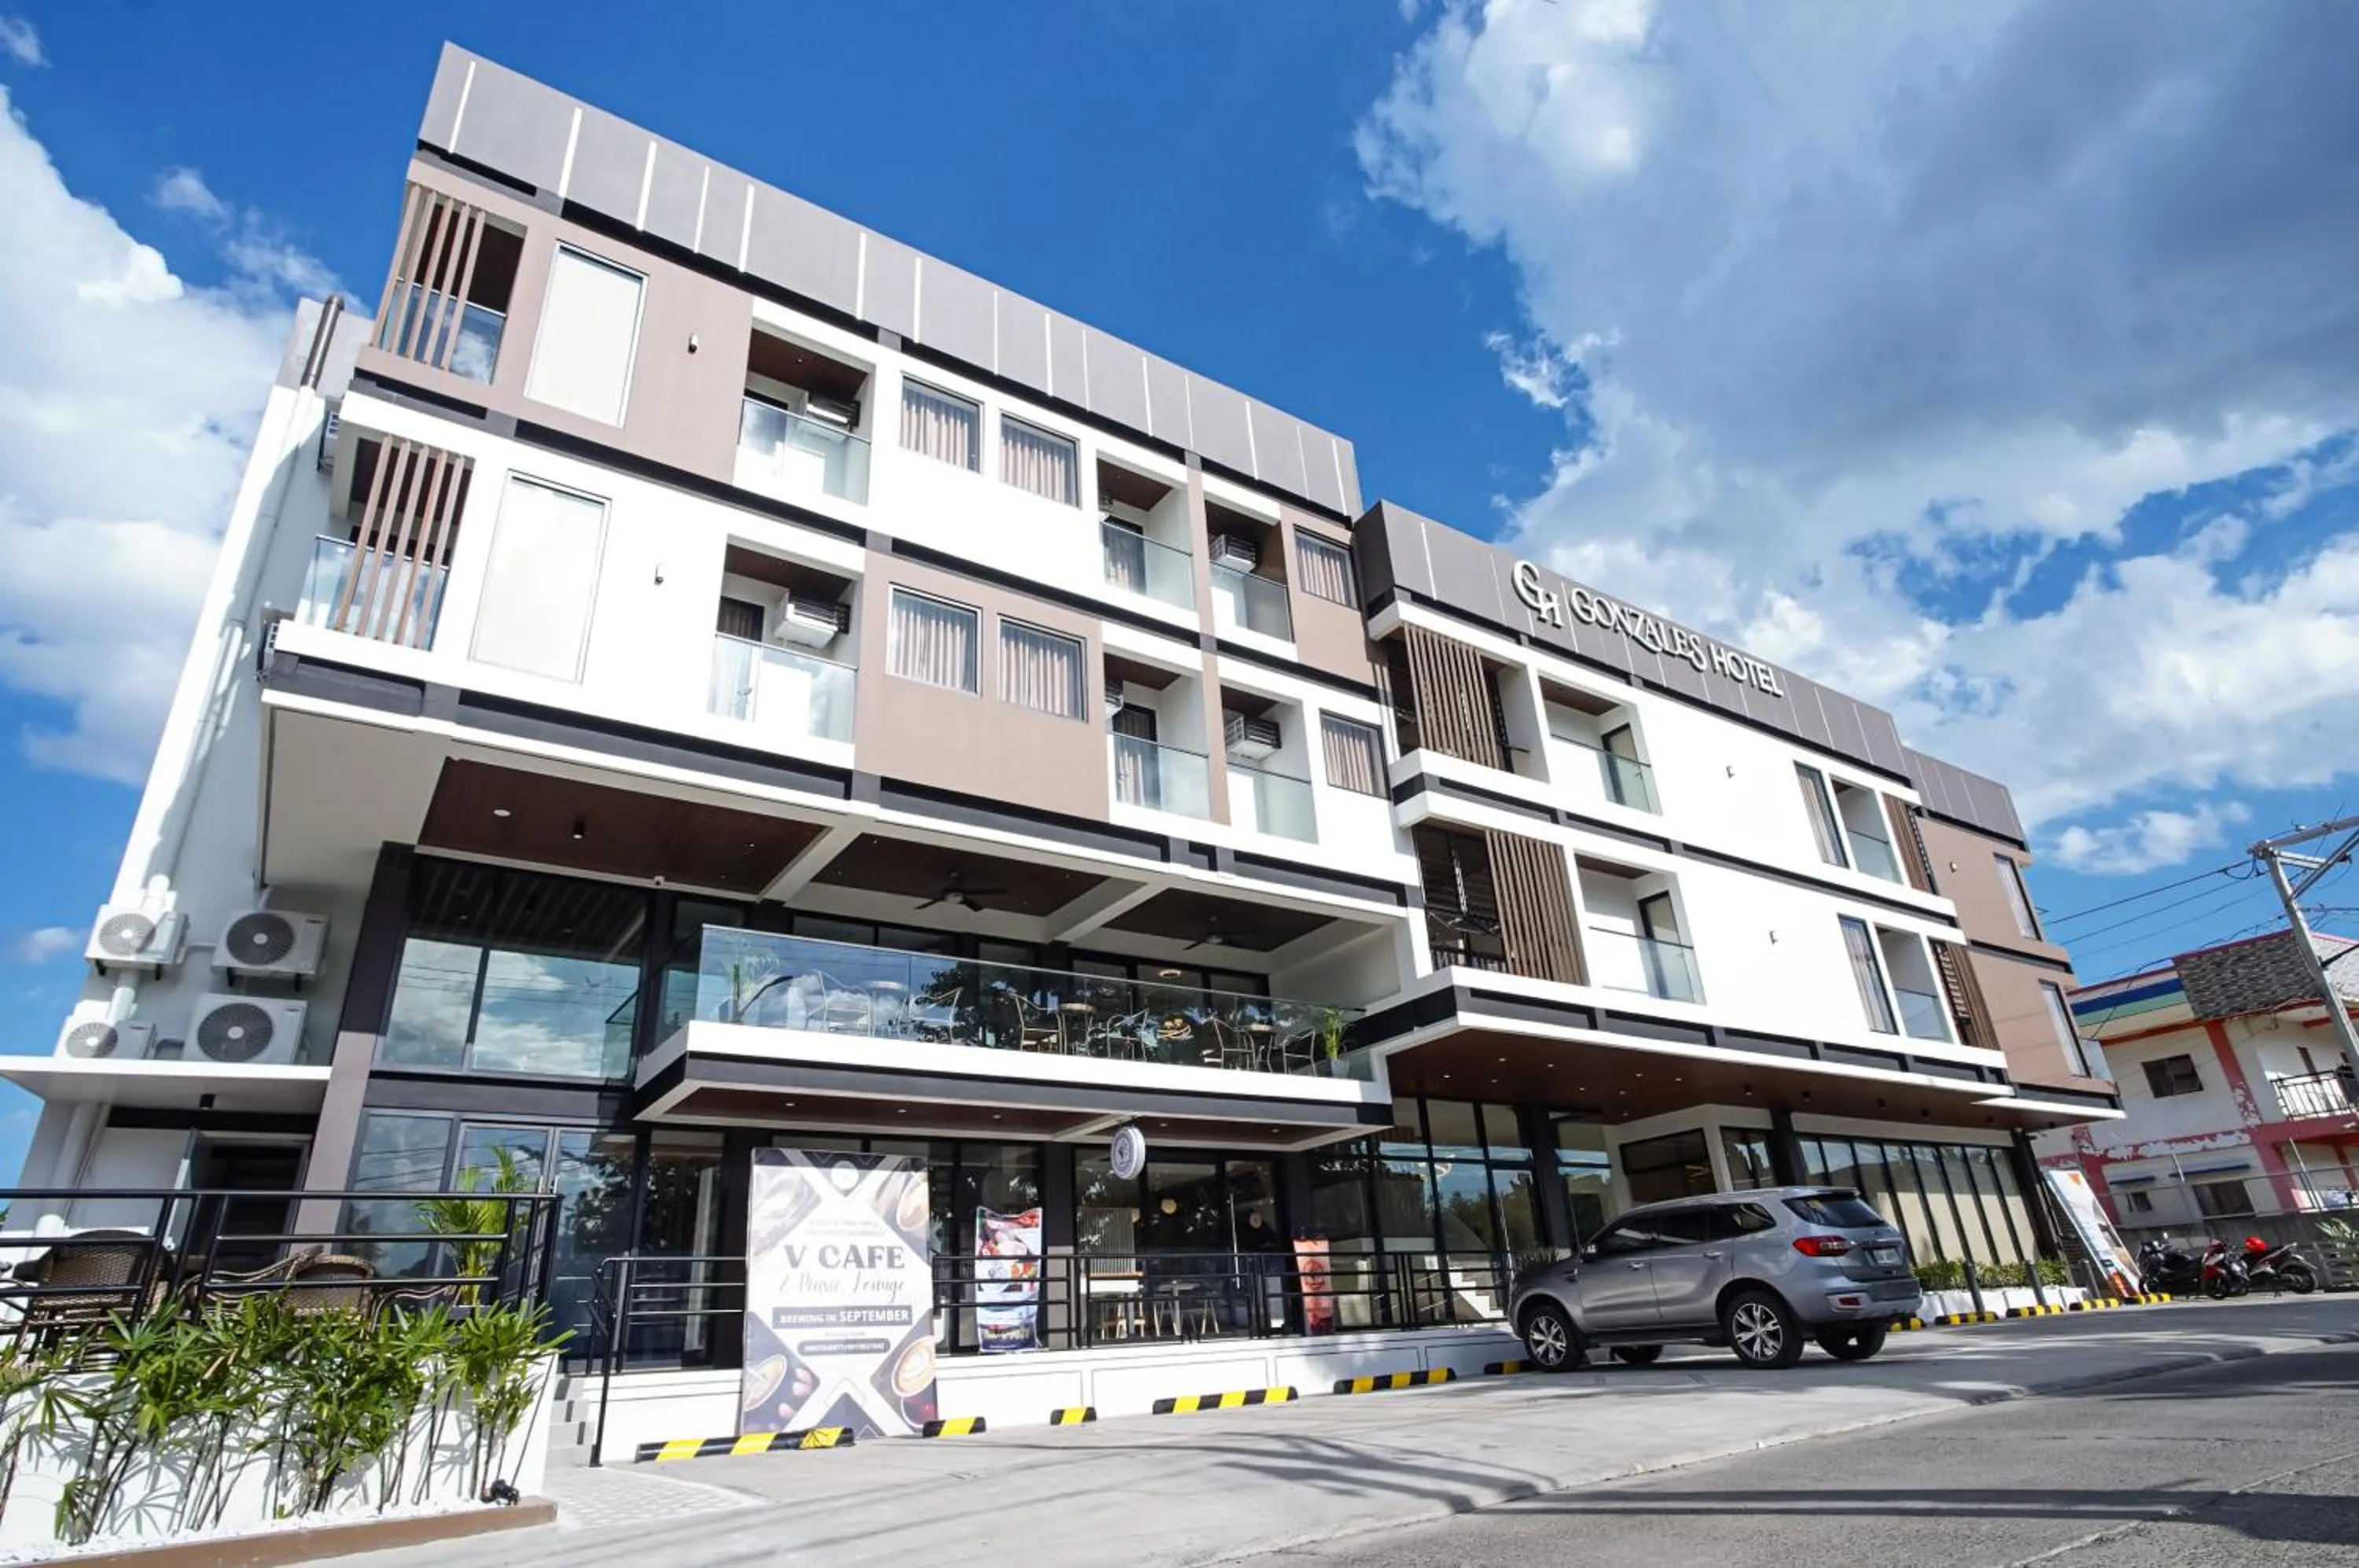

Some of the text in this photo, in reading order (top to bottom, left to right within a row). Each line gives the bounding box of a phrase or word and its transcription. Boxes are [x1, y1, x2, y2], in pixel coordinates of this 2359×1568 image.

[1570, 587, 1784, 698] GONZALES HOTEL
[783, 1244, 906, 1269] V CAFE
[839, 1309, 910, 1323] SEPTEMBER
